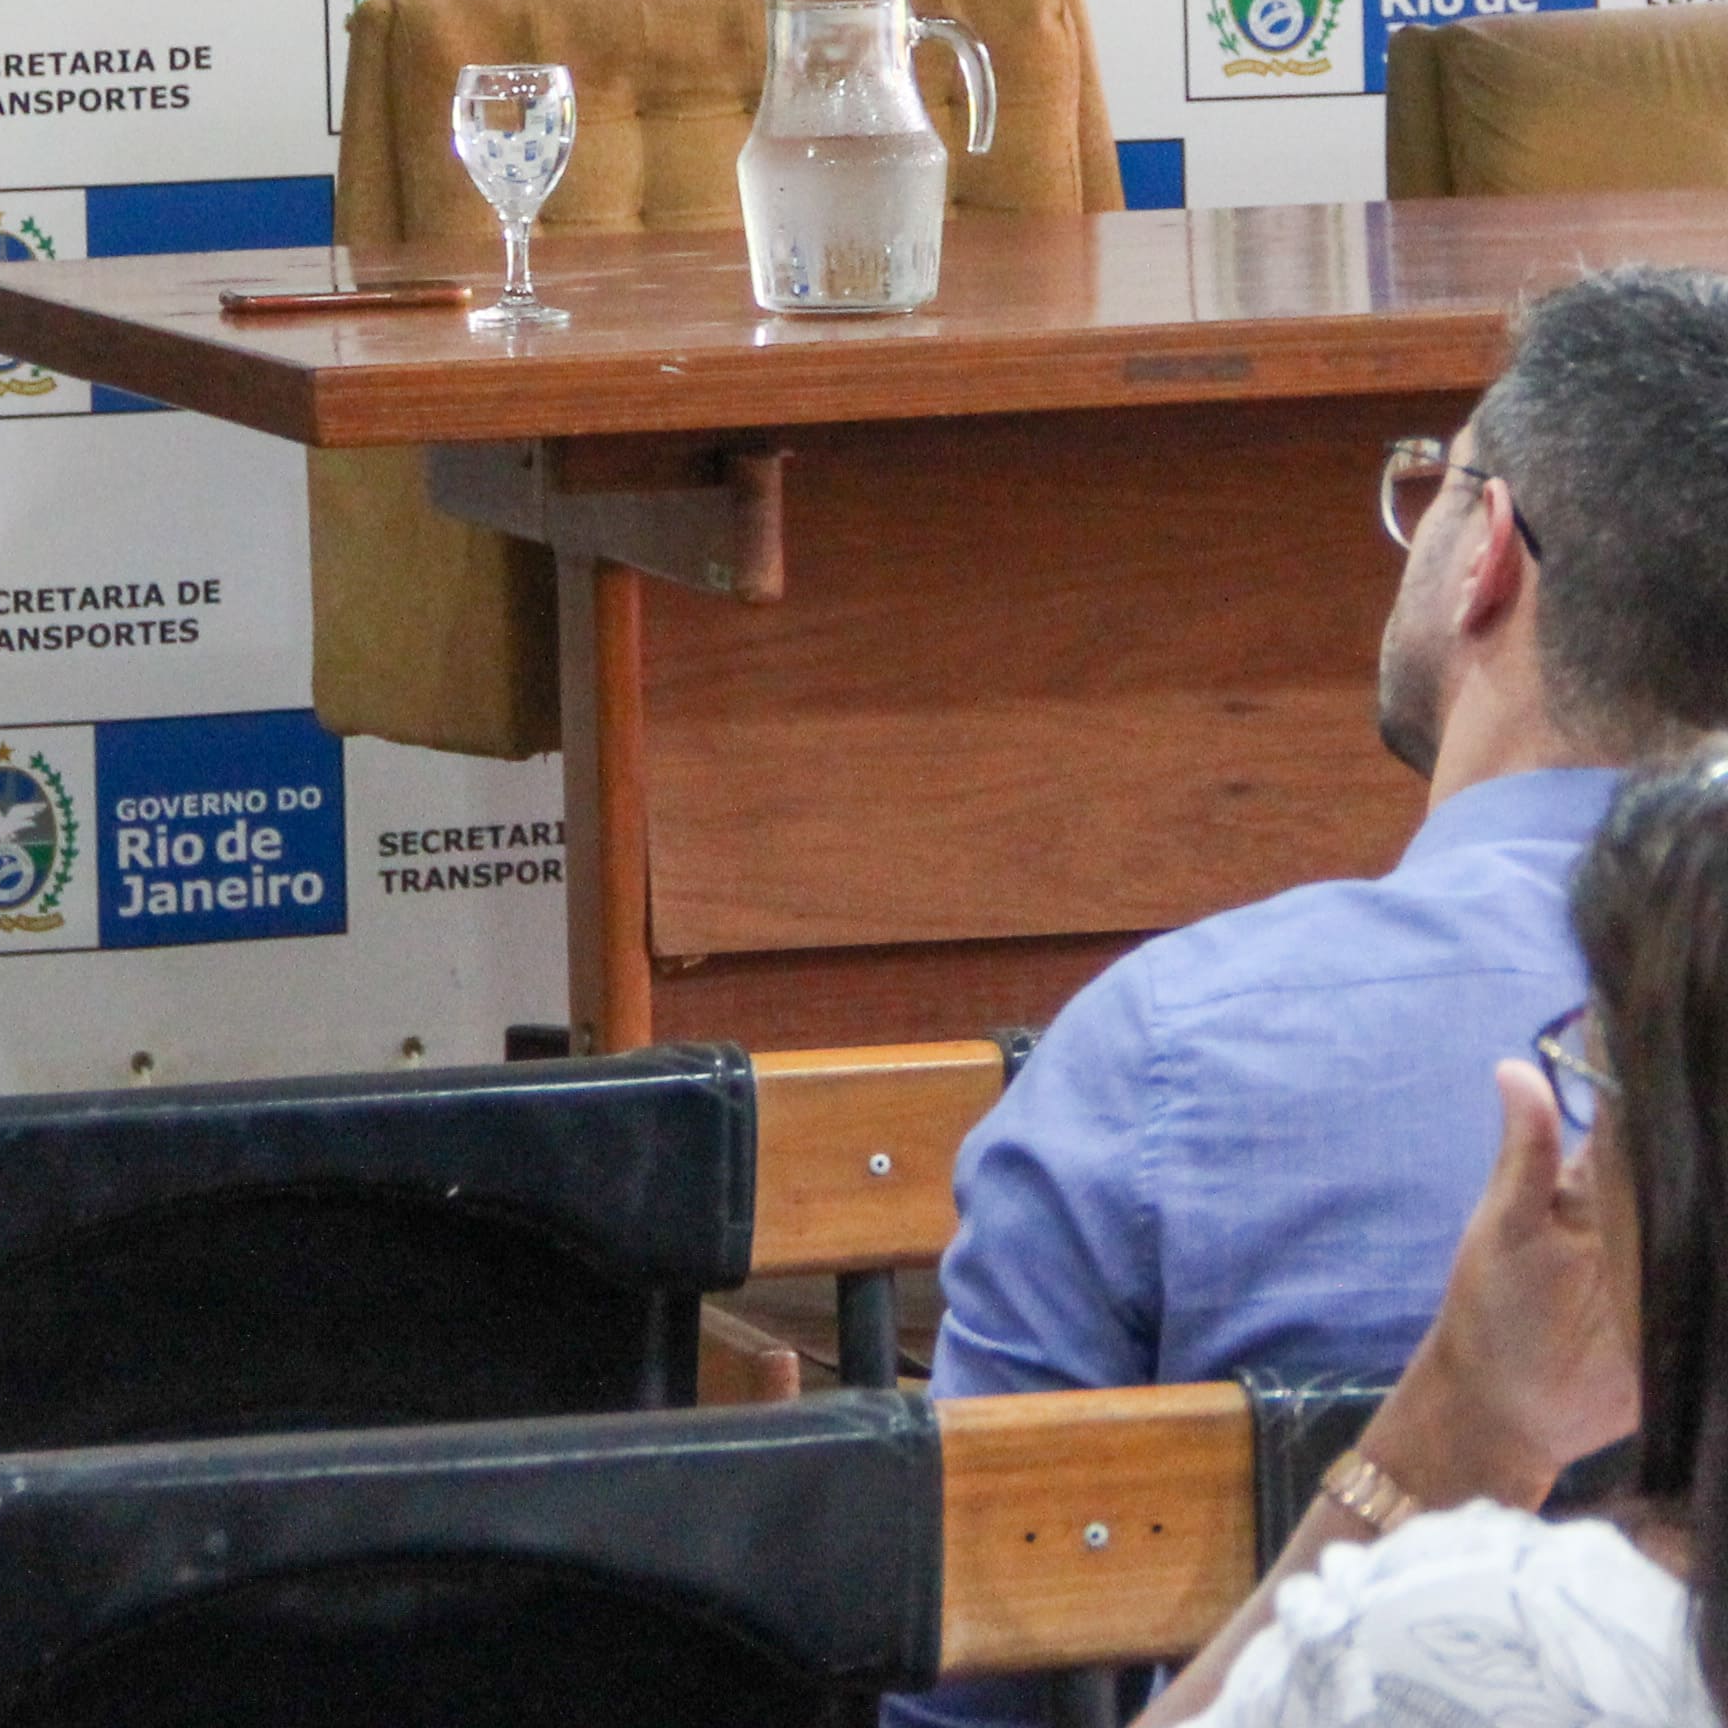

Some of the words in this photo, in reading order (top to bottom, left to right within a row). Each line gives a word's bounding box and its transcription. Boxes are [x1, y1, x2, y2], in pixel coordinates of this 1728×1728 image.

[169, 46, 211, 71] DE
[178, 579, 220, 605] DE
[116, 790, 267, 822] GOVERNO
[278, 786, 322, 811] DO
[117, 824, 205, 869] Rio
[215, 819, 282, 863] de
[379, 821, 566, 857] SECRETARI
[119, 864, 324, 917] Janeiro
[379, 859, 563, 894] TRANSPOR
